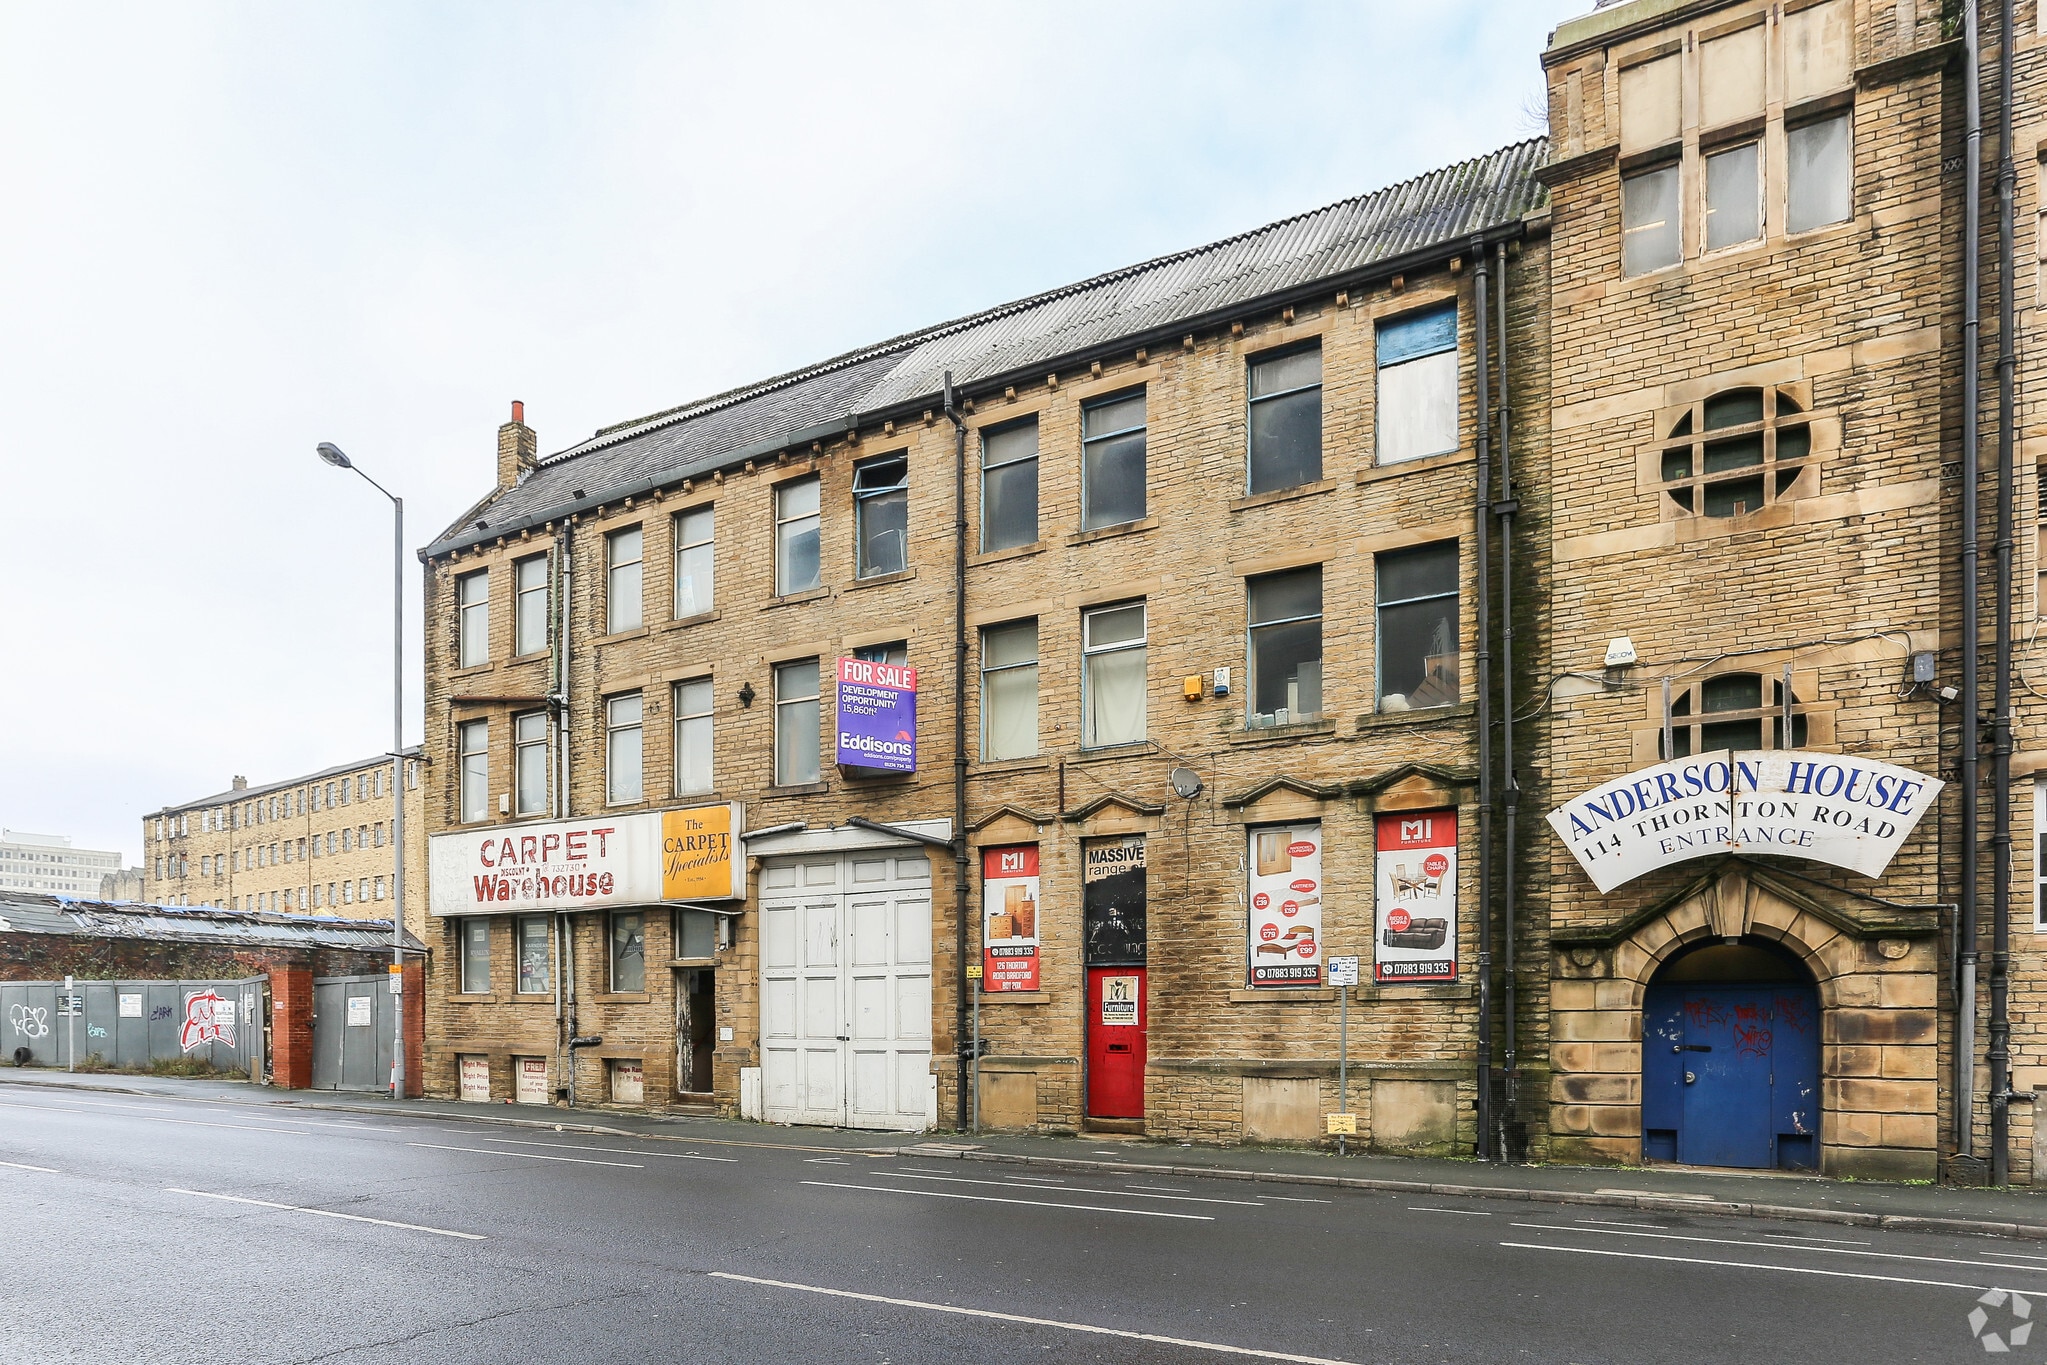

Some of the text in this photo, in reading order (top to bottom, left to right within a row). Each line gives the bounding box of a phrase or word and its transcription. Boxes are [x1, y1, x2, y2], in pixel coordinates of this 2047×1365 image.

[1608, 651, 1632, 659] SECOM
[844, 661, 911, 689] FOR SALE
[842, 684, 899, 700] DEVELOPMENT
[842, 694, 897, 709] OPPORTUNITY
[840, 732, 912, 756] Eddisons
[863, 752, 912, 763] eddisons.com/property
[1569, 761, 1923, 842] ANDERSON HOUSE
[685, 819, 704, 830] The
[1401, 819, 1432, 840] MI
[1584, 800, 1897, 863] 114 THORNTON ROAD
[480, 828, 615, 867] CARPET
[664, 833, 729, 853] CARPET
[1659, 826, 1815, 856] ENTRANCE
[664, 847, 729, 880] Specialists
[1001, 852, 1024, 870] MI
[1089, 847, 1144, 864] MASSIVE
[500, 867, 525, 877] DISCOUNT
[551, 863, 580, 873] 732730
[1089, 865, 1126, 875] range
[473, 867, 614, 902] Warehouse
[999, 948, 1014, 956] 07883
[1023, 946, 1034, 955] 335
[1267, 967, 1317, 978] 07883 919 335
[1394, 962, 1449, 975] 07883 919 335
[1104, 1002, 1134, 1012] Furniture
[525, 1062, 544, 1071] FREE
